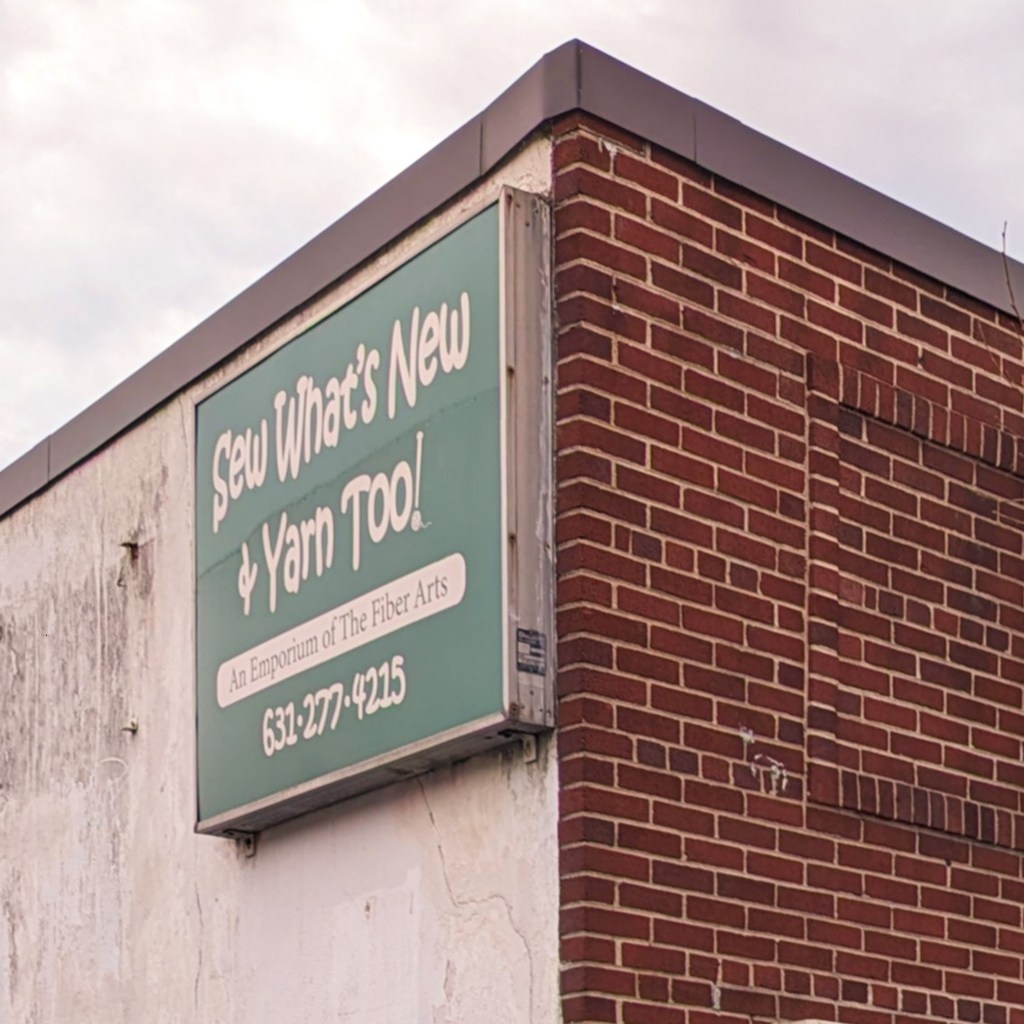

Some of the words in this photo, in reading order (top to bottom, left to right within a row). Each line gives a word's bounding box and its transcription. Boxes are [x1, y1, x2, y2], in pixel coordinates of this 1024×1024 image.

[212, 418, 268, 534] Sew
[274, 343, 380, 483] What's
[387, 291, 470, 420] New
[262, 506, 334, 614] Yarn
[229, 666, 247, 693] An
[250, 635, 319, 685] Emporium
[322, 616, 338, 649] of
[338, 609, 368, 642] The
[371, 592, 410, 628] Fiber
[413, 576, 448, 609] Arts
